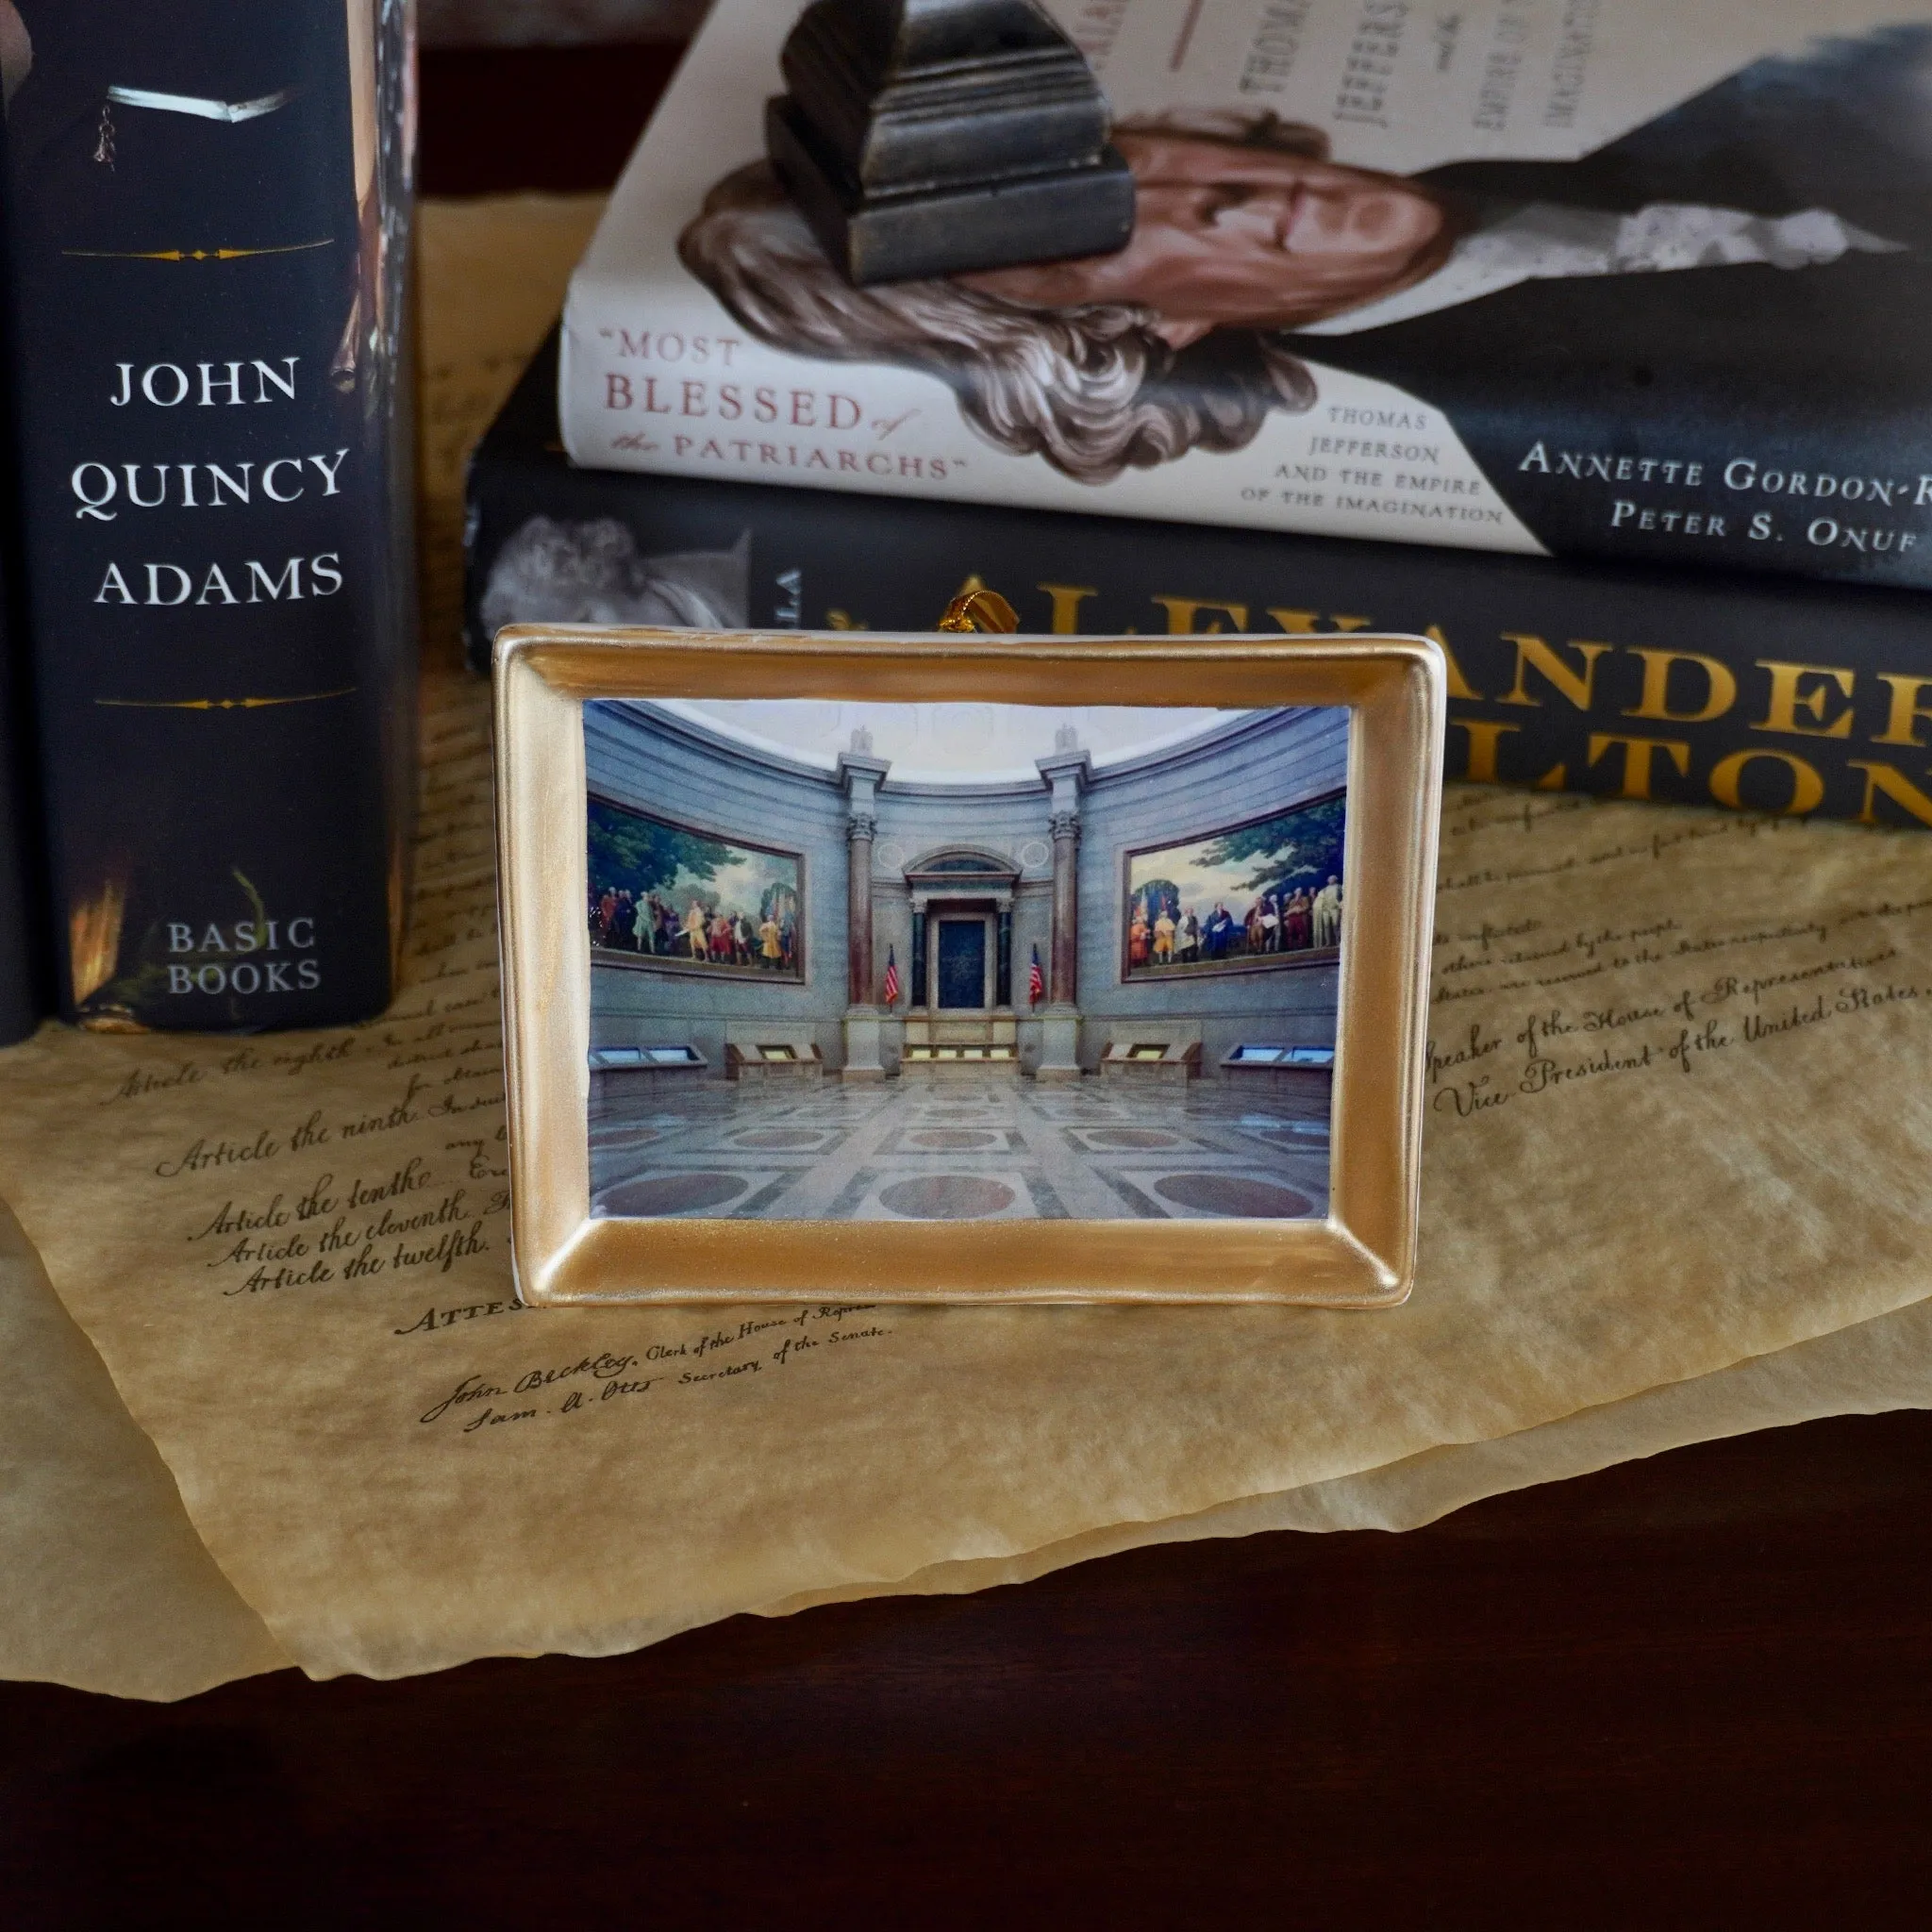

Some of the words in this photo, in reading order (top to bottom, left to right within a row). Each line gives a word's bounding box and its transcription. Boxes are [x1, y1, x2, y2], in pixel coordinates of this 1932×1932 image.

[110, 357, 299, 408] JOHN
[605, 374, 862, 430] BLESSED
[1328, 406, 1428, 430] THOMAS
[1308, 435, 1441, 466] JEFFERSON
[1519, 440, 1704, 487] ANNETTE
[71, 448, 350, 521] QUINCY
[1275, 464, 1327, 483] AND
[1339, 469, 1384, 488] THE
[1393, 474, 1482, 496] EMPIRE
[1240, 488, 1271, 502] OF
[1280, 491, 1324, 508] THE
[1336, 494, 1504, 525] IMAGINATION
[1609, 500, 1726, 538] PETER
[1747, 510, 1784, 542] S.
[1806, 515, 1918, 554] ONUF
[94, 552, 344, 607] ADAMS
[168, 917, 316, 953] BASIC
[168, 958, 322, 995] BOOKS
[1516, 1014, 1539, 1059] of
[1541, 1009, 1579, 1038] the
[1582, 1008, 1668, 1032] House
[1674, 991, 1696, 1022] of
[1701, 946, 1897, 1006] Representatives
[220, 1047, 263, 1075] the
[1433, 1074, 1516, 1117] Vice
[1520, 1043, 1655, 1094] President
[1668, 1029, 1691, 1074] of
[1694, 1019, 1734, 1051] the
[1742, 994, 1832, 1043] United
[1835, 984, 1919, 1013] States
[155, 1129, 280, 1178] Article
[290, 1108, 332, 1153] the
[187, 1193, 290, 1242] Article
[296, 1173, 341, 1221] the
[206, 1233, 309, 1268] Article
[318, 1216, 361, 1254] the
[223, 1260, 336, 1296] Article
[343, 1243, 387, 1281] the
[419, 1374, 508, 1424] John
[645, 1343, 688, 1361] Clerk
[692, 1335, 711, 1358] of
[708, 1330, 736, 1351] the
[737, 1320, 787, 1341] House
[792, 1309, 809, 1326] of
[773, 1338, 792, 1365] of
[793, 1335, 820, 1353] the
